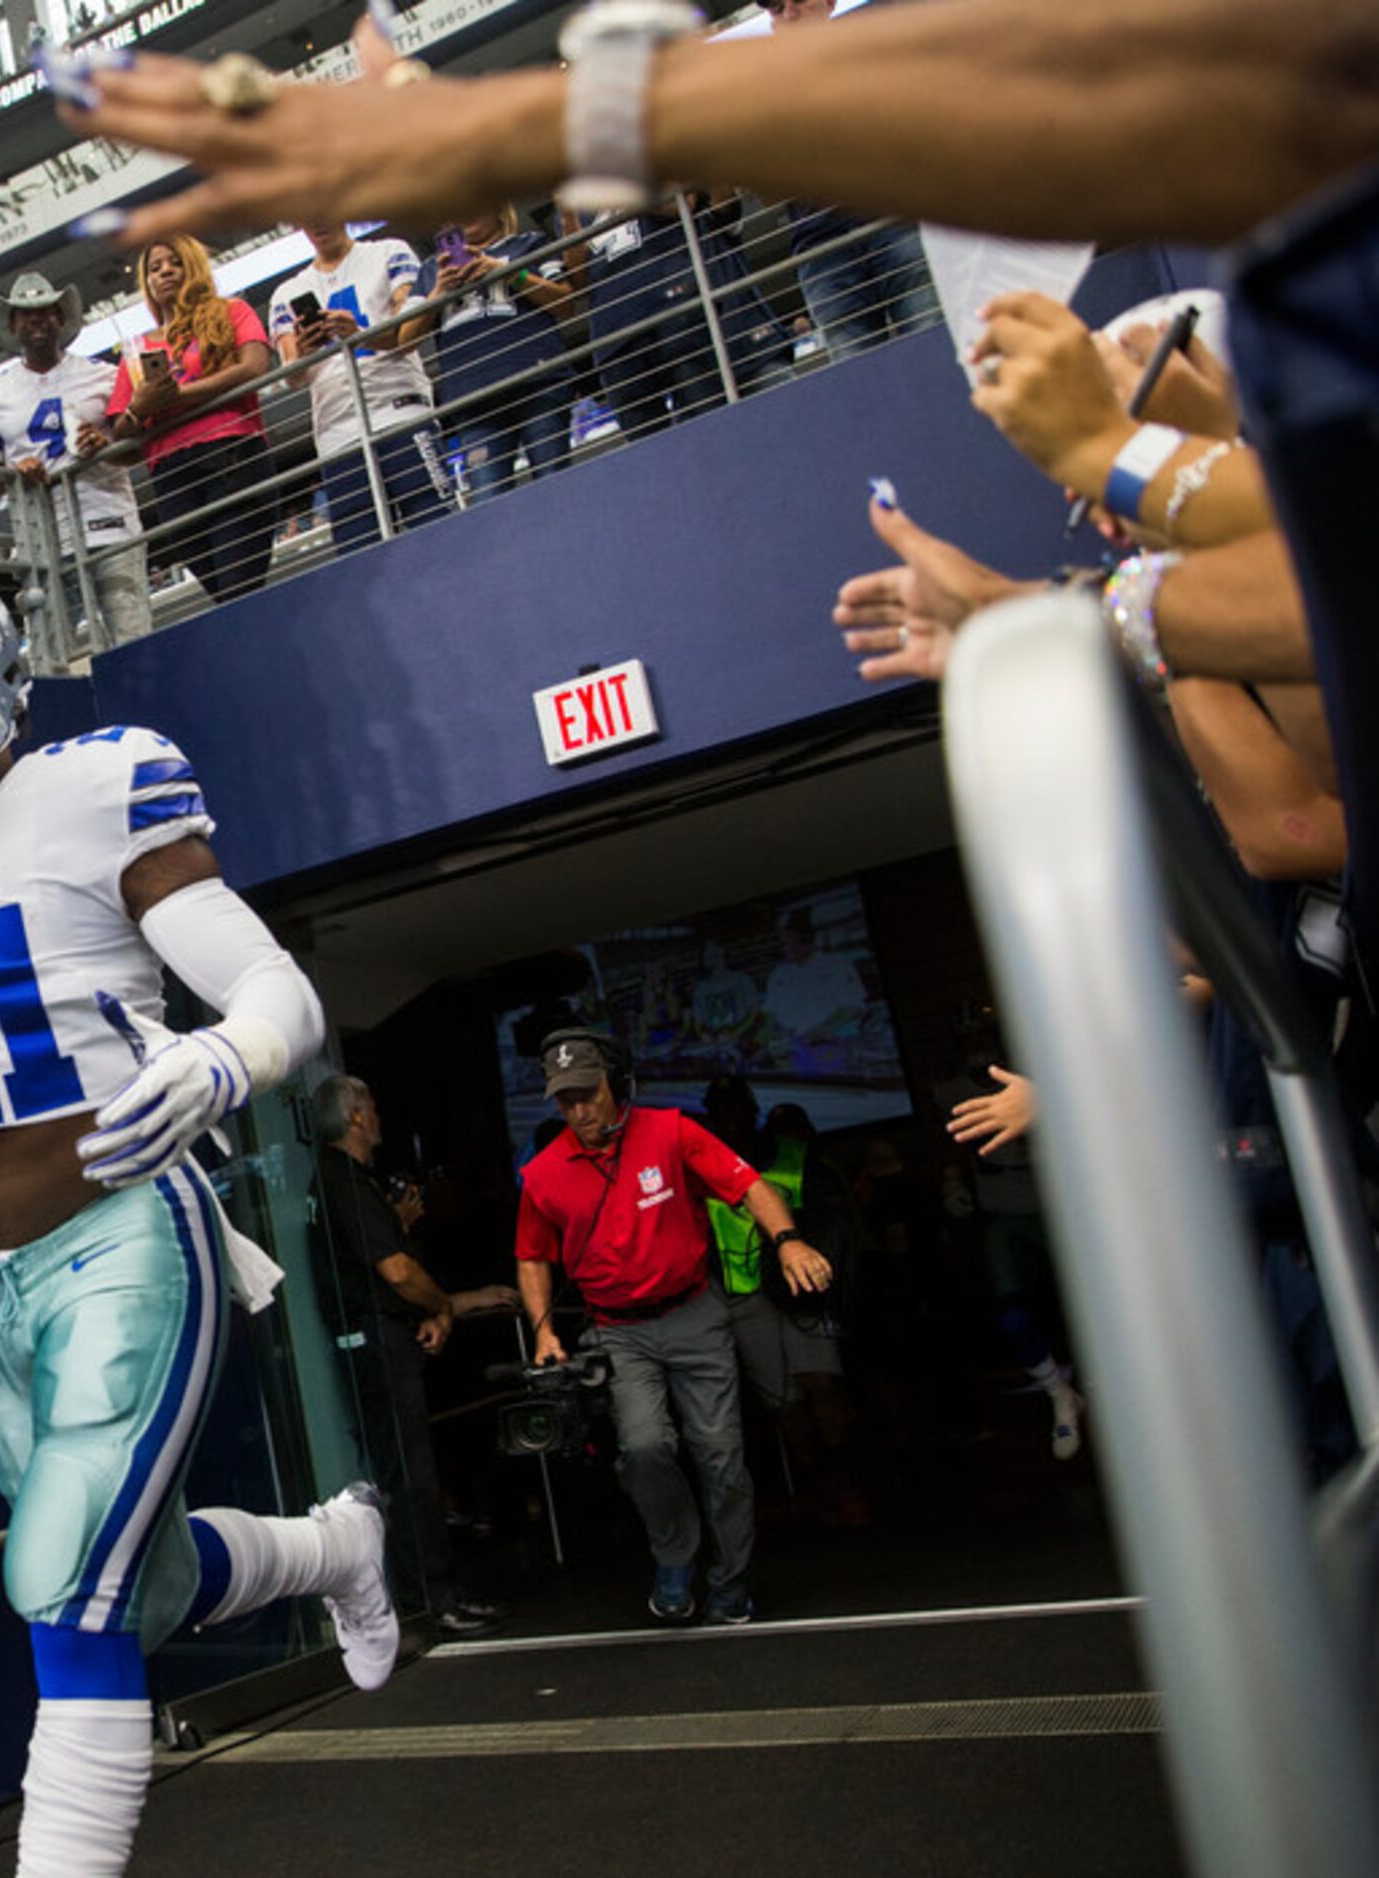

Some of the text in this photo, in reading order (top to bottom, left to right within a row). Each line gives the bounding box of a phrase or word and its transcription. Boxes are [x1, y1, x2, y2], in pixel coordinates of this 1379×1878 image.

[100, 19, 137, 53] THE
[27, 397, 67, 459] 4
[554, 672, 633, 751] EXIT
